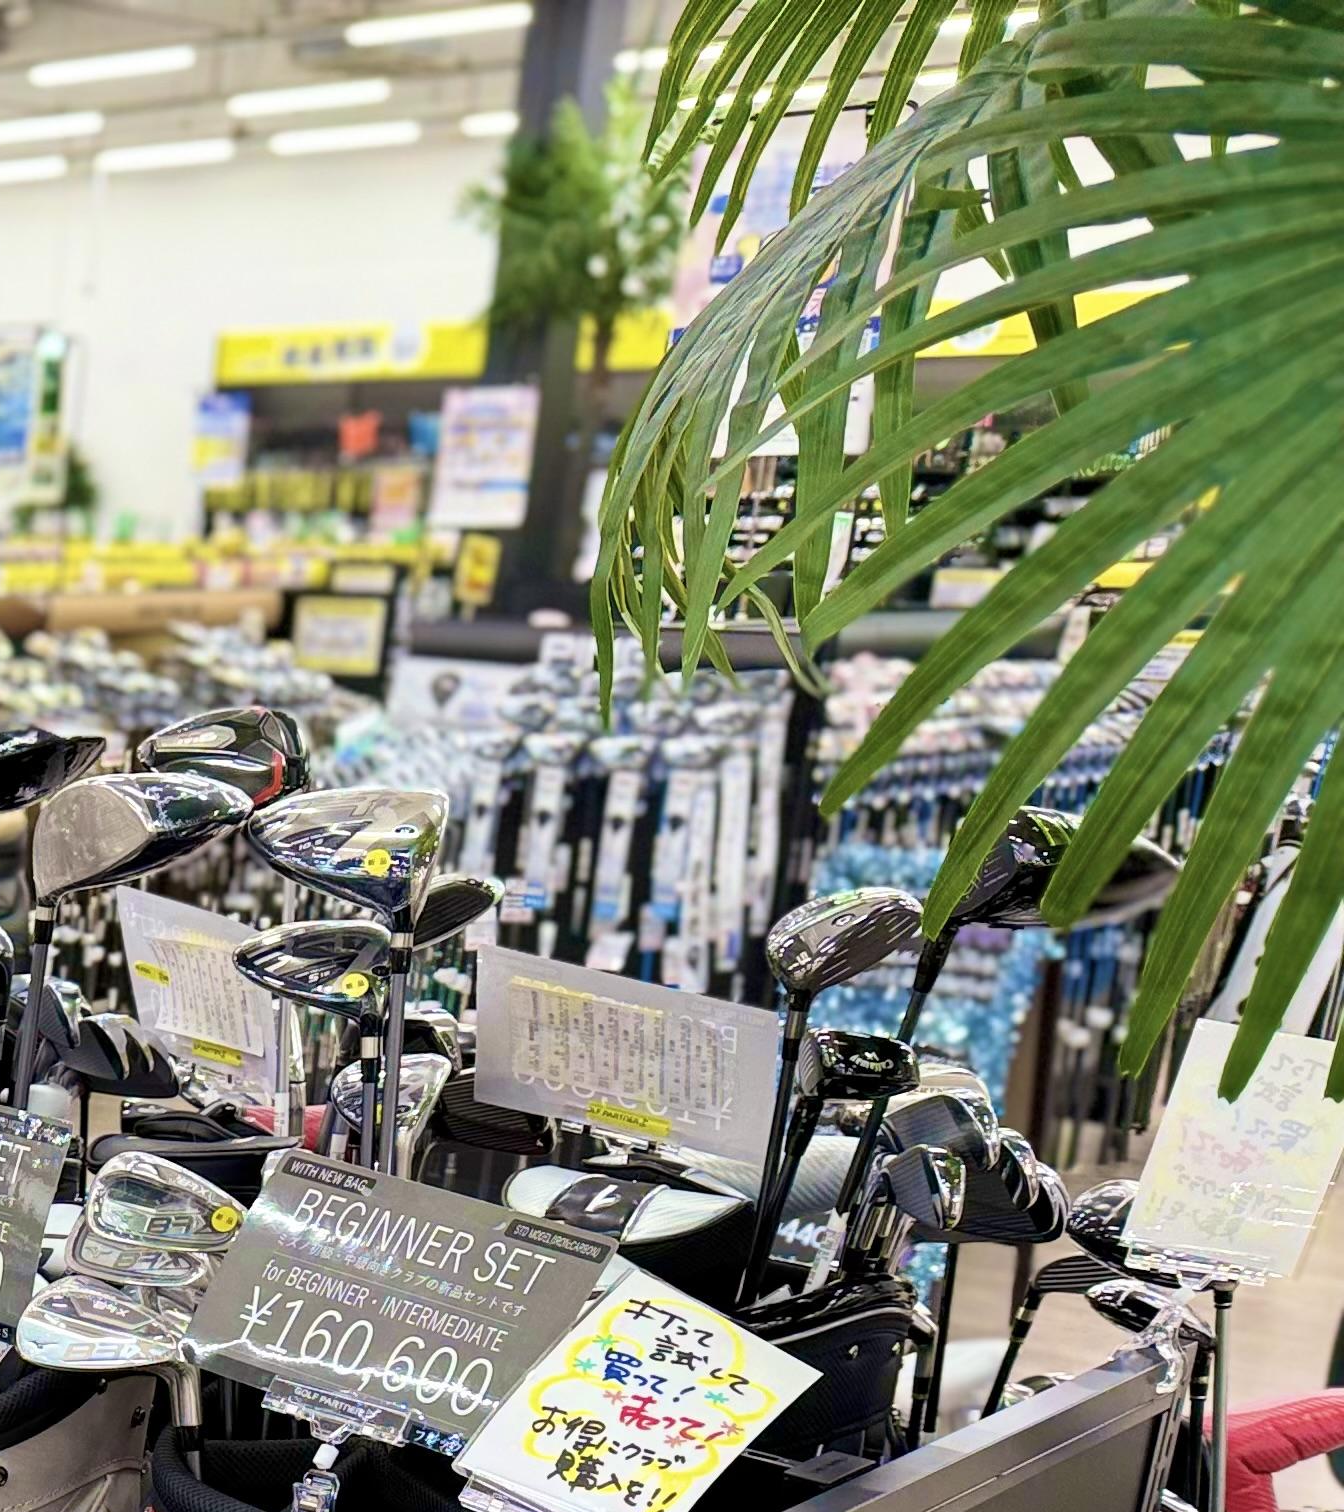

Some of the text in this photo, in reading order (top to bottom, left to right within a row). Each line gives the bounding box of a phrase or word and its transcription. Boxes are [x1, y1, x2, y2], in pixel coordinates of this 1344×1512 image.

[288, 1159, 370, 1192] WITH NEW BAG
[293, 1186, 557, 1297] BEGINNER SET
[261, 1257, 509, 1353] for BEGINNER INTERMEDIATE
[238, 1285, 497, 1417] ¥160,600
[649, 1334, 753, 1395] 試して
[293, 1385, 319, 1401] GOLF
